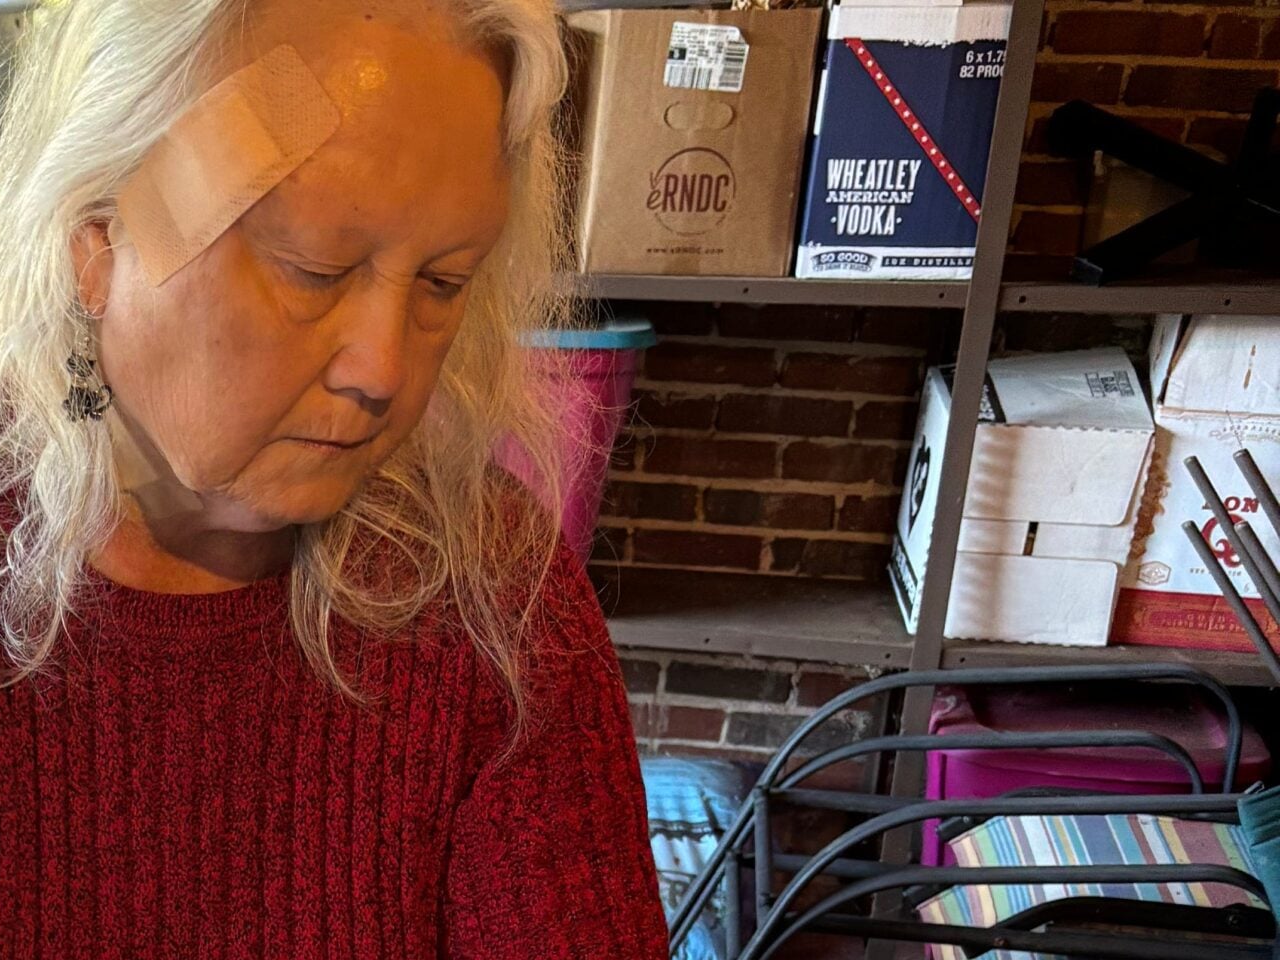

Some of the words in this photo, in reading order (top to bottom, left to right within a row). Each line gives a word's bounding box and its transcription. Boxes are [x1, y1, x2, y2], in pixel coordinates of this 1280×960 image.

[966, 50, 975, 63] 6
[976, 52, 984, 63] x
[959, 65, 975, 78] 82
[827, 158, 922, 190] WHEATLEY
[646, 173, 730, 213] eRNDC
[825, 191, 914, 204] AMERICAN
[836, 204, 896, 236] VODKA
[820, 253, 836, 263] SO
[837, 252, 869, 263] GOOD
